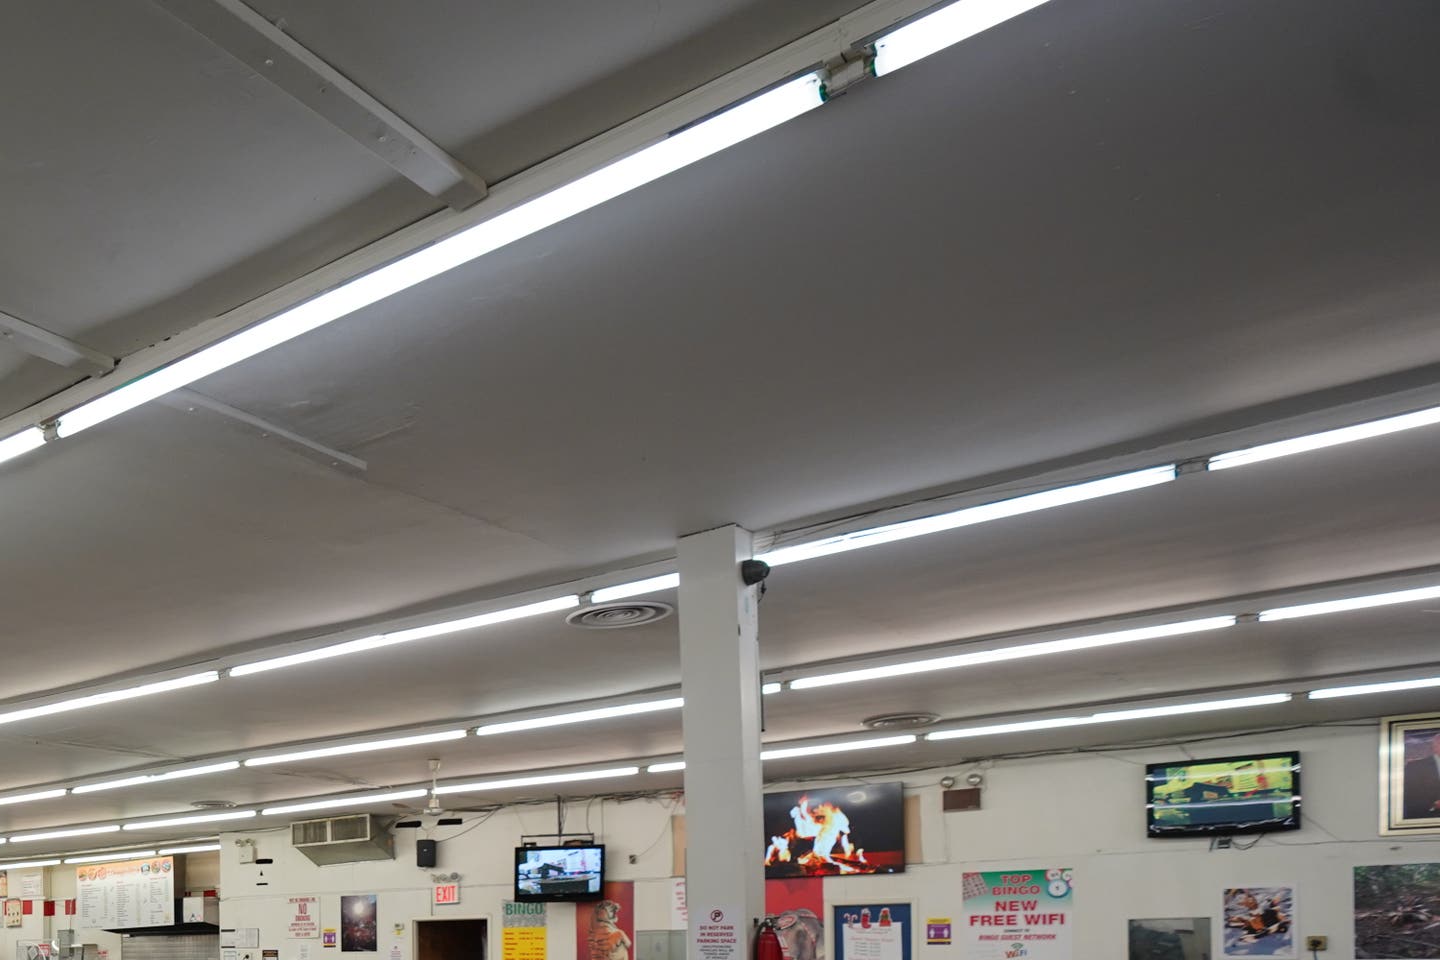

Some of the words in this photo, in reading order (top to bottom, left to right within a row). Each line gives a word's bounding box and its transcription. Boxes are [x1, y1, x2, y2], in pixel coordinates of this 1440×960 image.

[1001, 874, 1032, 884] TOP
[436, 886, 456, 902] EXIT
[992, 885, 1041, 896] BINGO
[505, 903, 543, 915] BINGO
[995, 900, 1038, 912] NEW
[970, 914, 1017, 926] FREE
[1025, 913, 1065, 925] WIFI
